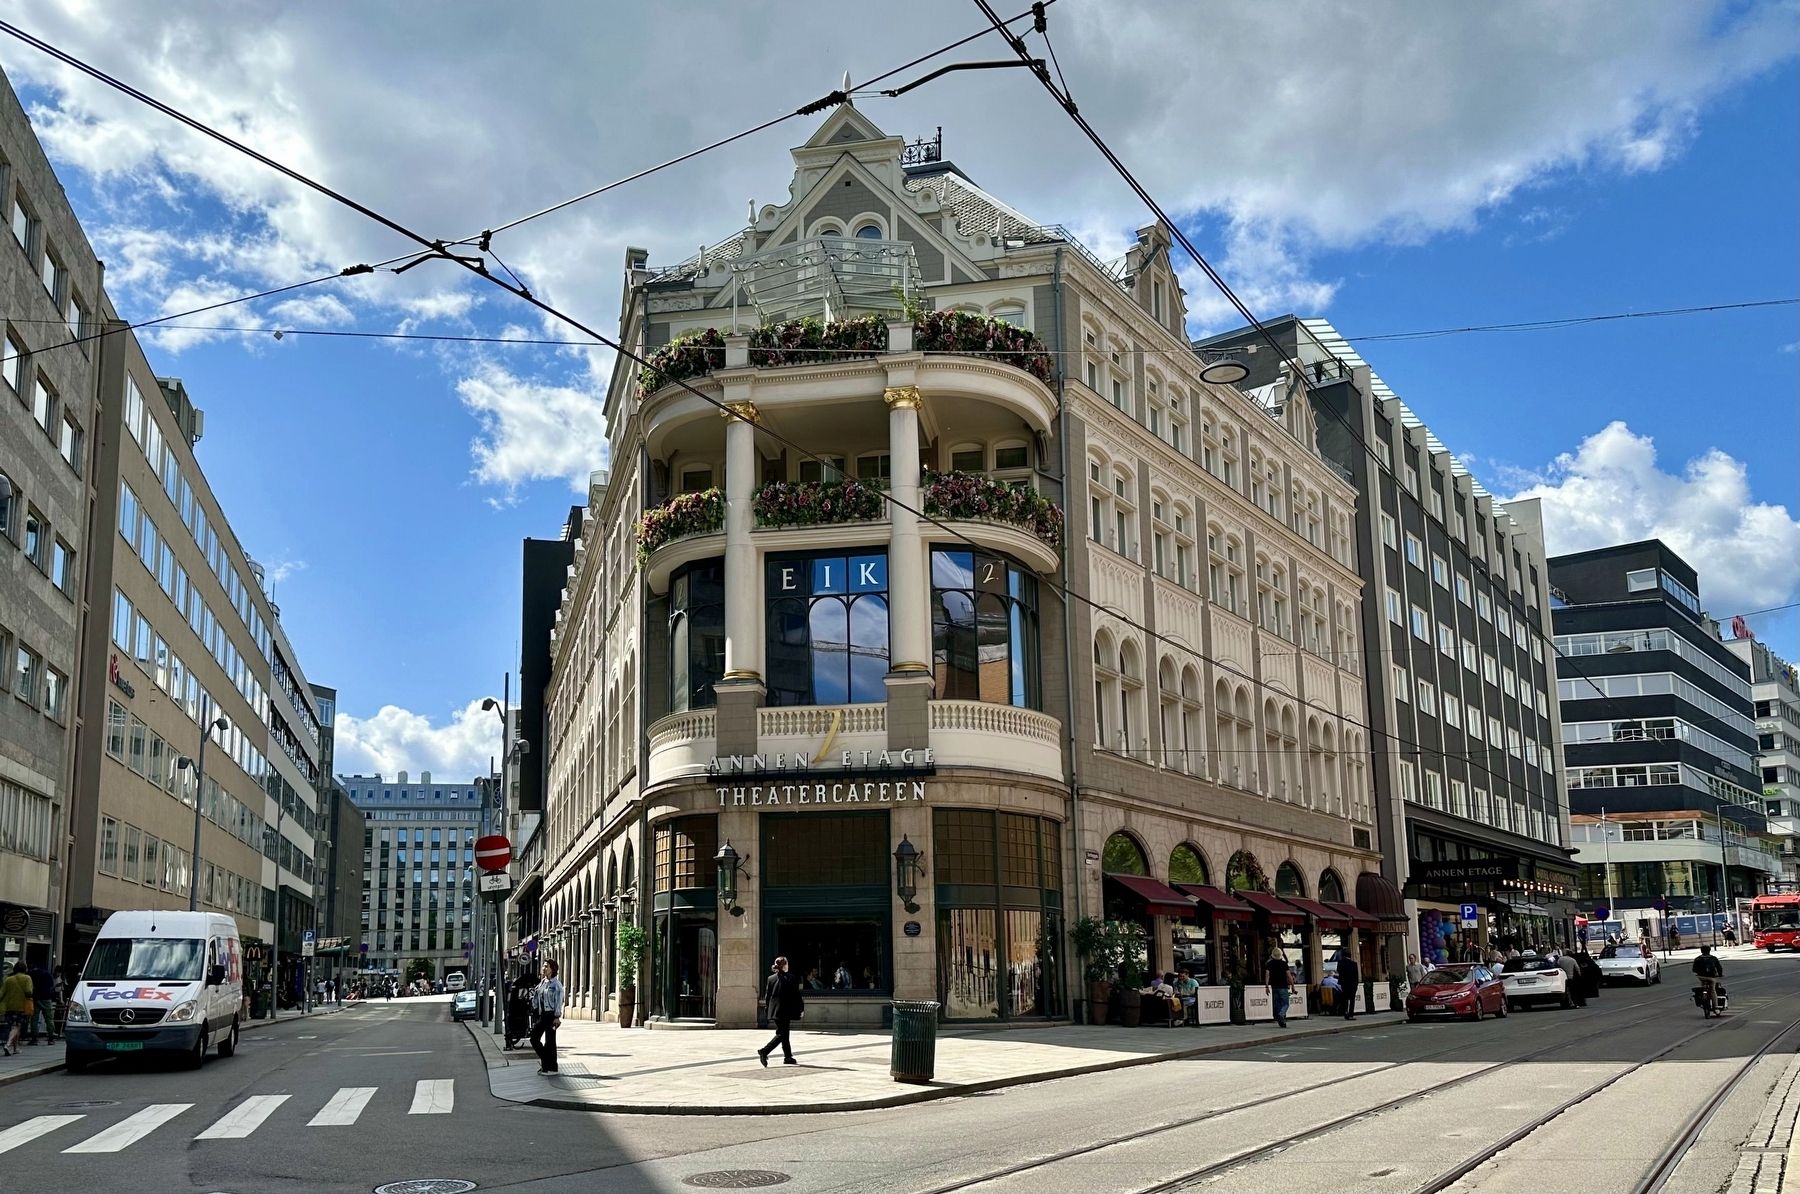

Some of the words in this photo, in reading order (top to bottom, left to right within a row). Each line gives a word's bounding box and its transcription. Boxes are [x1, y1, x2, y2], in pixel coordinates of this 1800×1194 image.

[782, 562, 879, 590] EIK
[708, 752, 809, 770] ANNEN
[842, 748, 935, 766] ETAGE
[716, 782, 926, 806] THEATERCAFEEN
[1426, 868, 1465, 877] ANNEN
[1469, 866, 1503, 876] ETAGE
[1464, 906, 1473, 918] P
[305, 931, 313, 941] P
[89, 987, 174, 1002] FedEx
